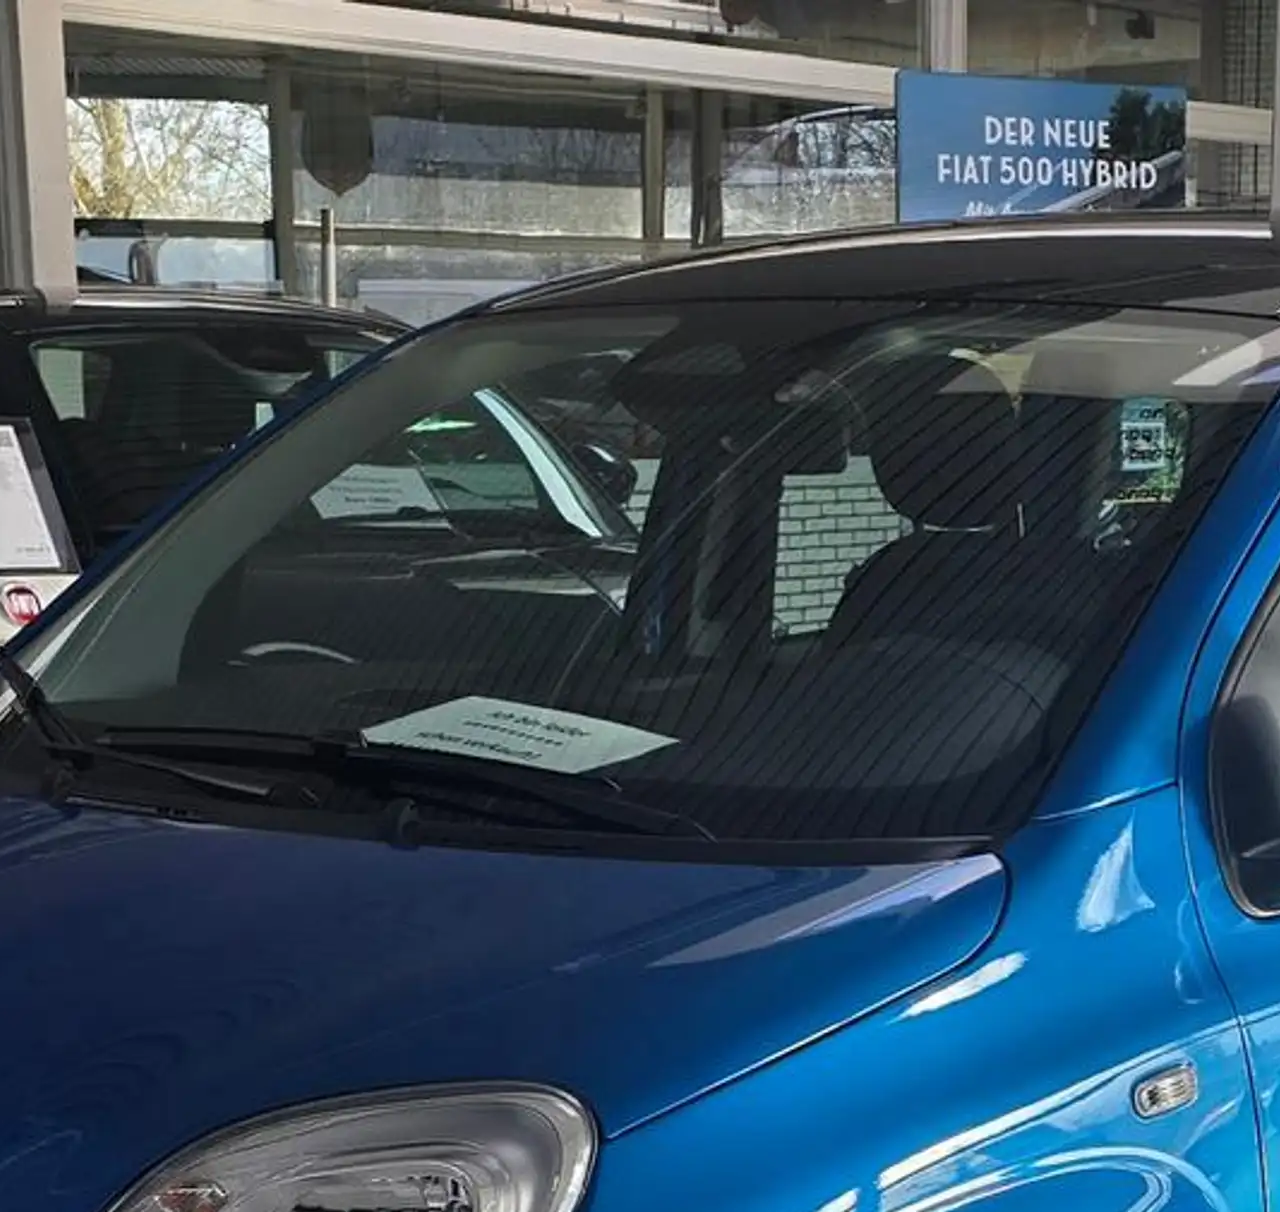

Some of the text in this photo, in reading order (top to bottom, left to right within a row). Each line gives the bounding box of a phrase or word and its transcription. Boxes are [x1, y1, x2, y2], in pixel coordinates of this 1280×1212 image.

[984, 115, 1112, 149] DER NEUE
[937, 153, 1158, 190] FIAT 500 HYBRID
